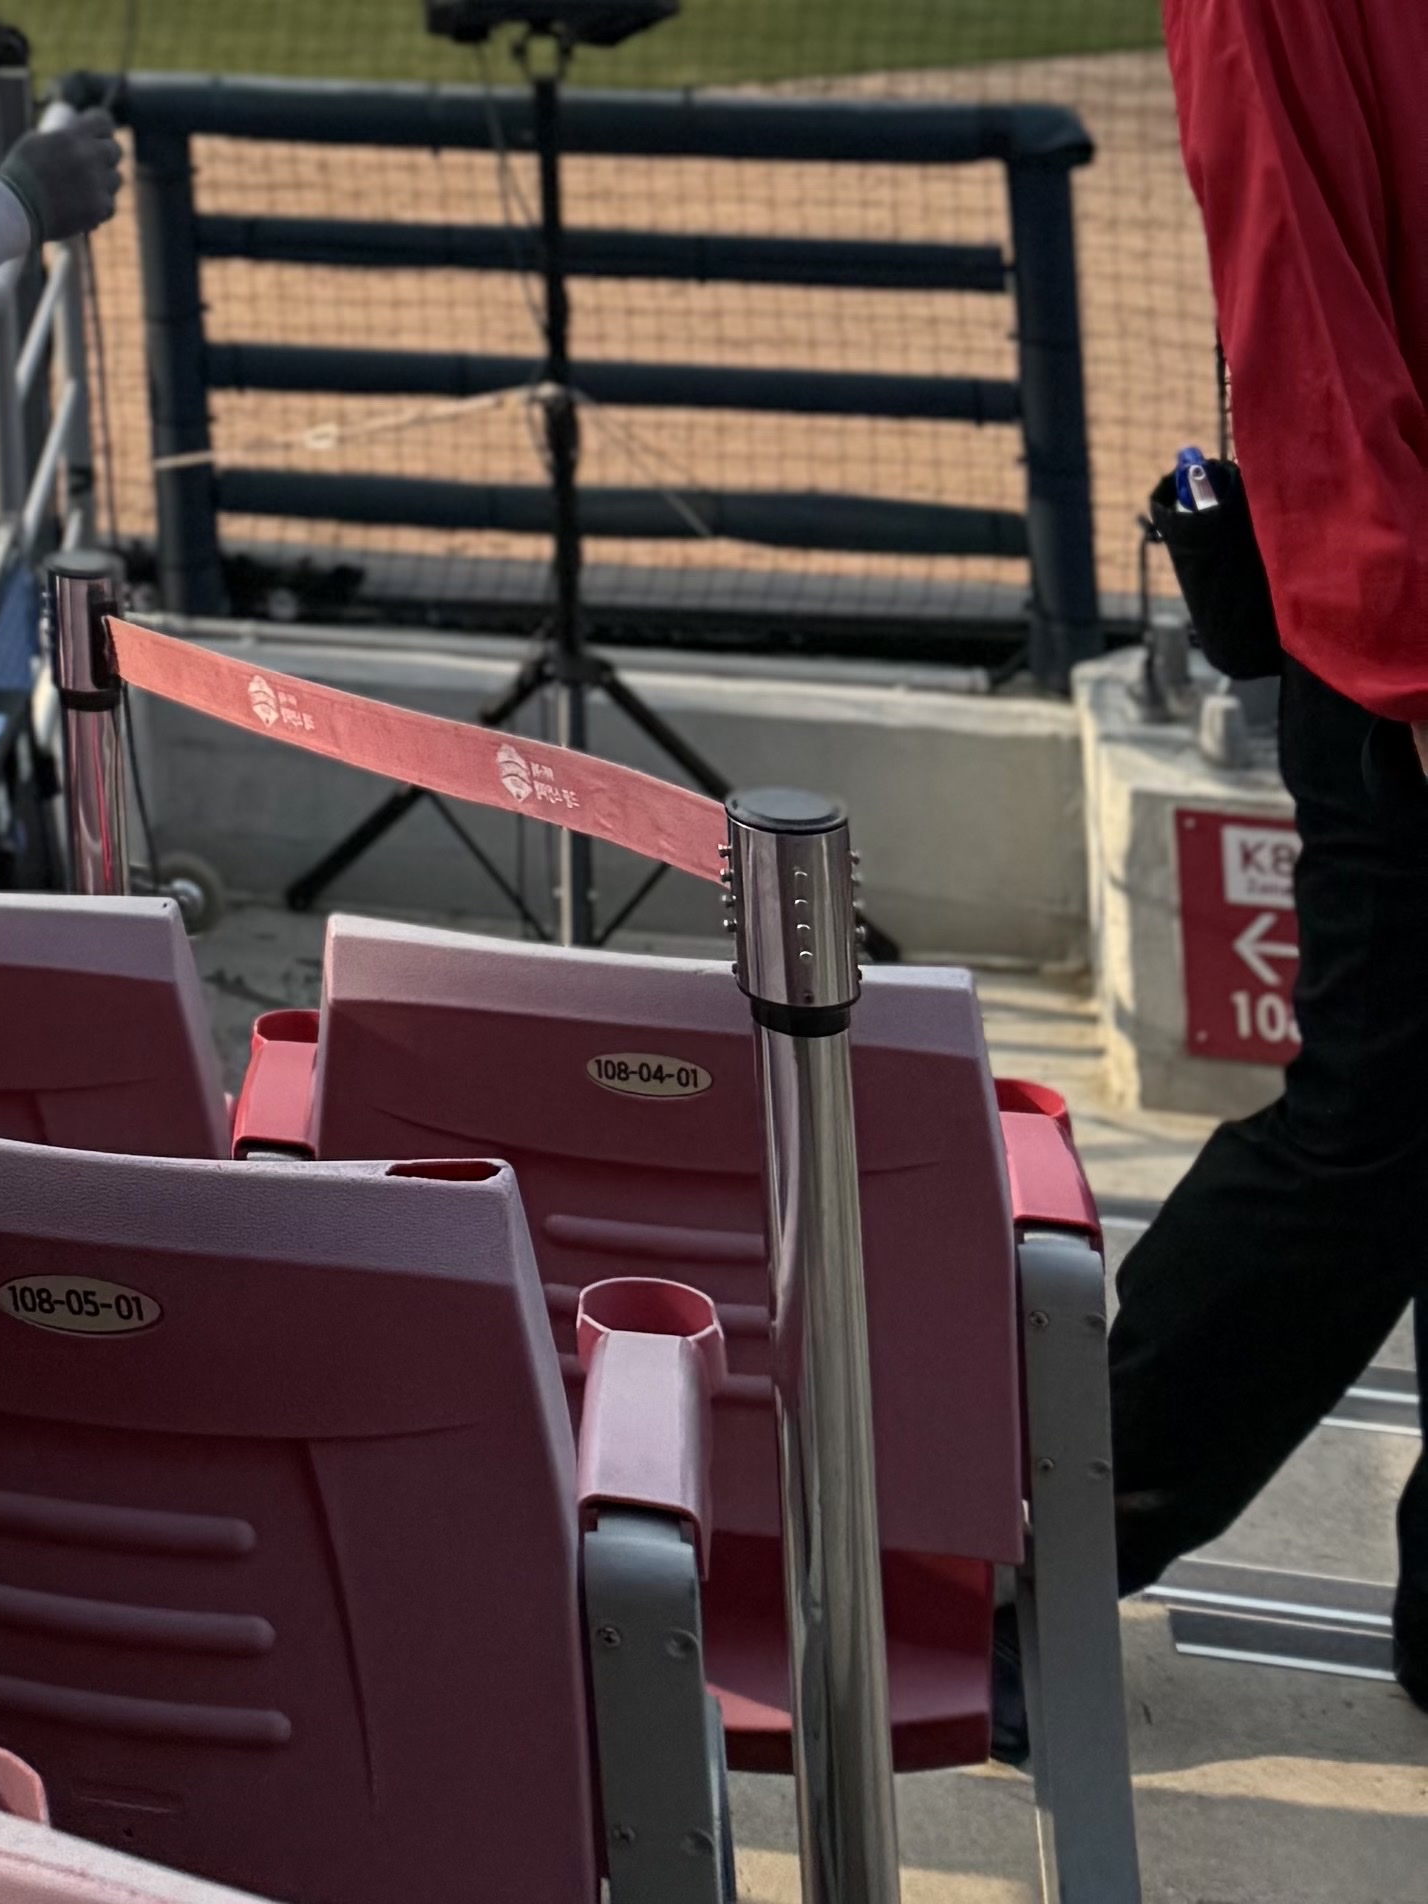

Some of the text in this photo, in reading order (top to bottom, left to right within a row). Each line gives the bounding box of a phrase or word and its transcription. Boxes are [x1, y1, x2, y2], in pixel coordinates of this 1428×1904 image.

[1230, 991, 1302, 1044] 10
[594, 1059, 699, 1088] 108-04-01
[7, 1285, 144, 1321] 108-05-01
